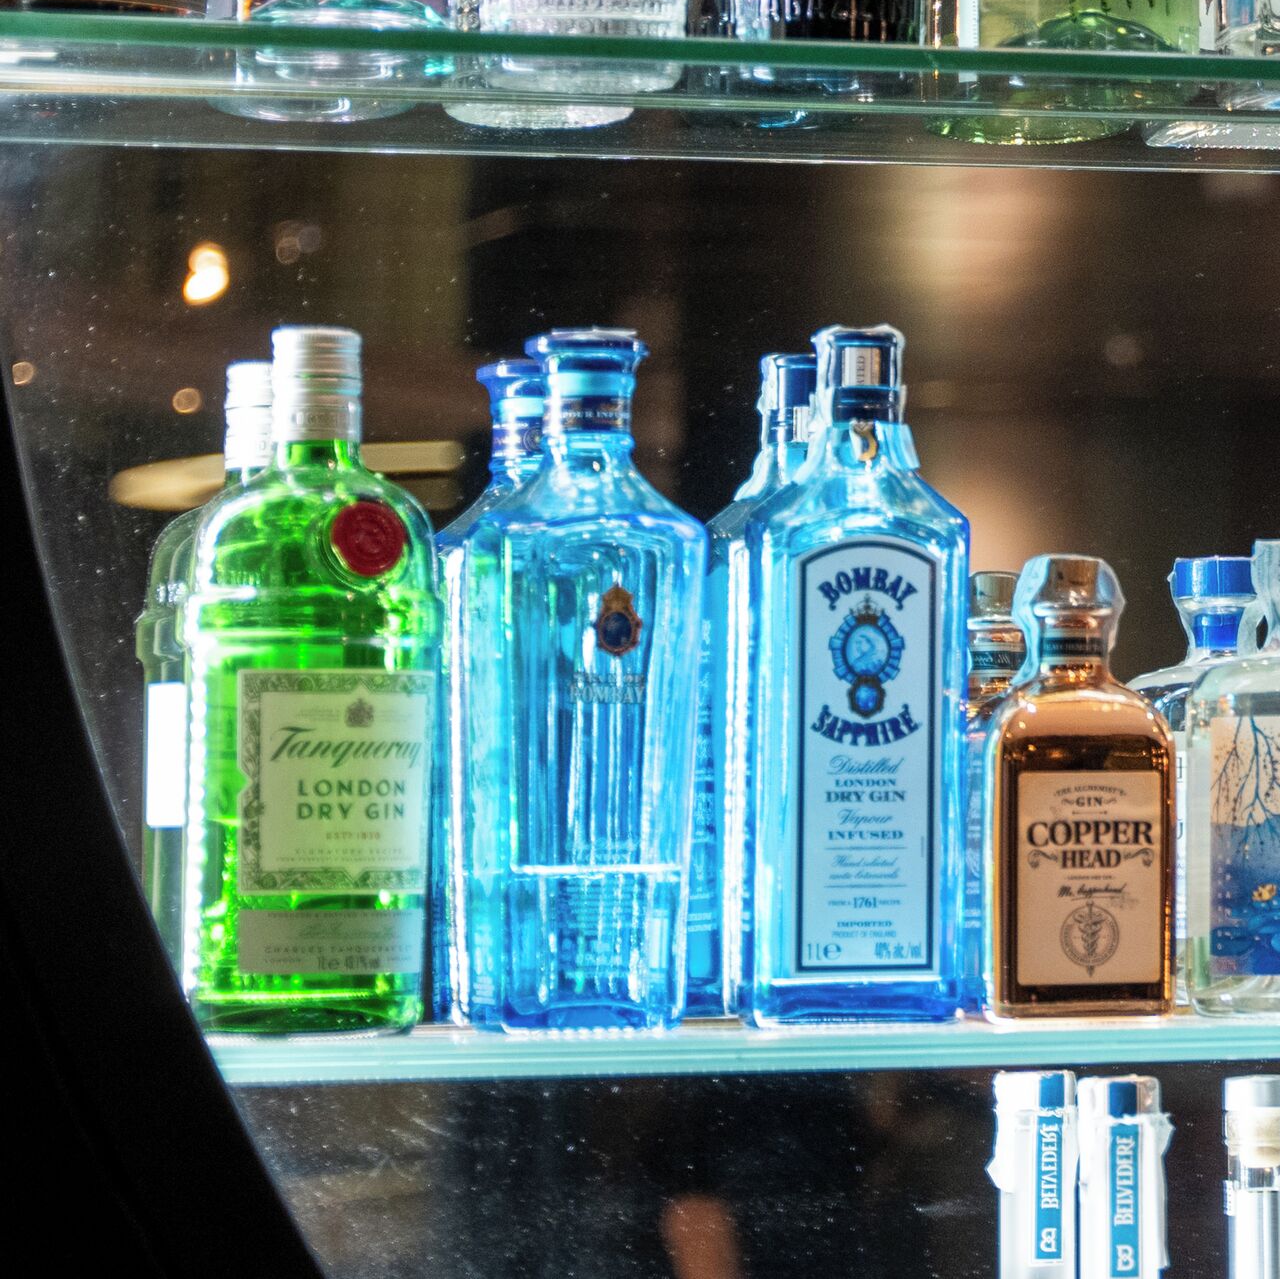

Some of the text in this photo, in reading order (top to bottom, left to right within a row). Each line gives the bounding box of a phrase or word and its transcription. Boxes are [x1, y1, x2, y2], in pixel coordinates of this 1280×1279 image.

[817, 567, 917, 611] BOMBAY
[810, 704, 921, 746] SAPPHIRE
[270, 726, 422, 768] Tanqueray
[827, 754, 904, 775] Distilled
[297, 780, 406, 796] LONDON
[835, 779, 896, 787] LONDON
[825, 791, 906, 803] DRY GIN
[1076, 797, 1103, 807] GIN
[297, 803, 404, 820] DRY GIN
[829, 831, 903, 840] INFUSED
[1027, 821, 1153, 846] COPPER
[1061, 849, 1121, 869] HEAD
[852, 897, 877, 909] 1761
[1114, 1136, 1135, 1227] BELVEDERE
